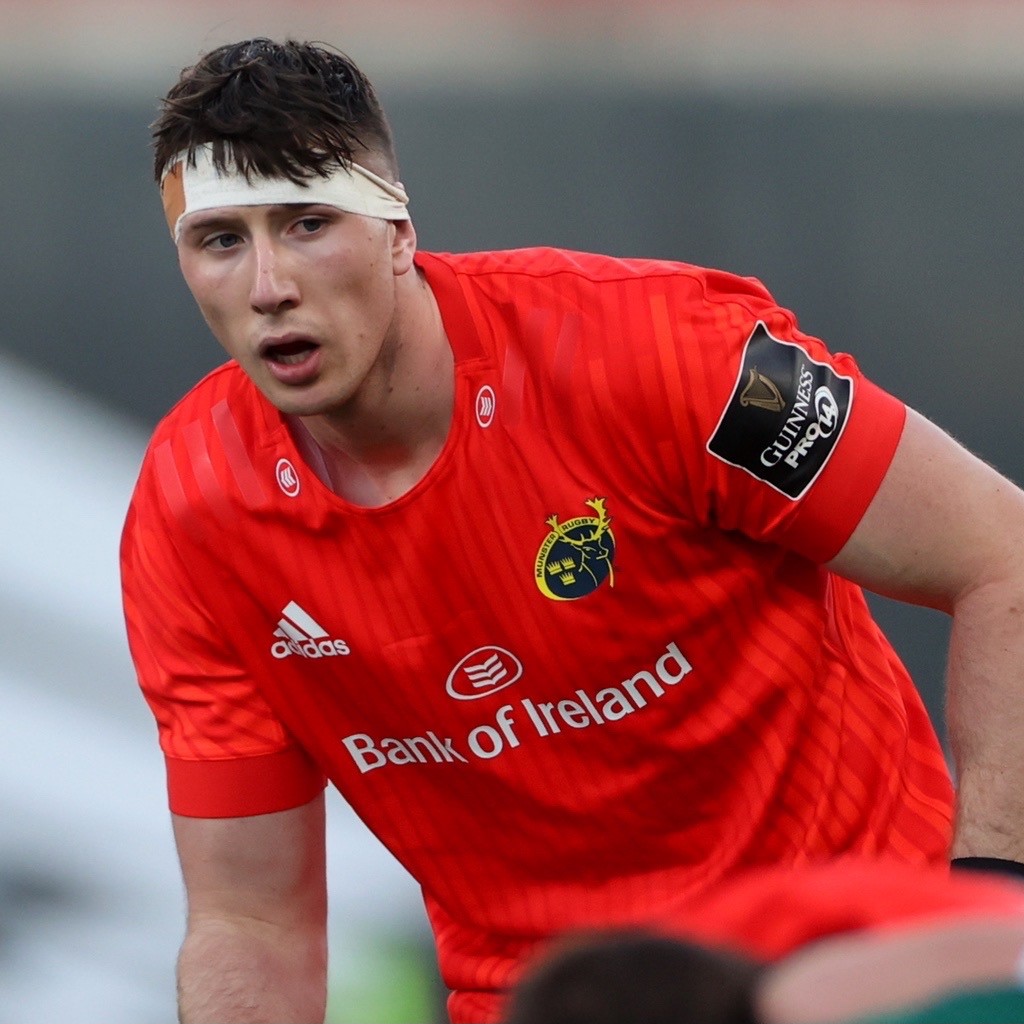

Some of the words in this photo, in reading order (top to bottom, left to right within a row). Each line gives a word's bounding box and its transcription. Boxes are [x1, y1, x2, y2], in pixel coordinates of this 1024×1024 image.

[759, 363, 814, 467] GUINNESS
[561, 518, 596, 531] RUGBY
[536, 533, 557, 578] MUNSTER
[271, 636, 351, 659] adidas
[341, 730, 469, 773] Bank
[467, 704, 522, 760] of
[520, 641, 694, 738] Ireland
